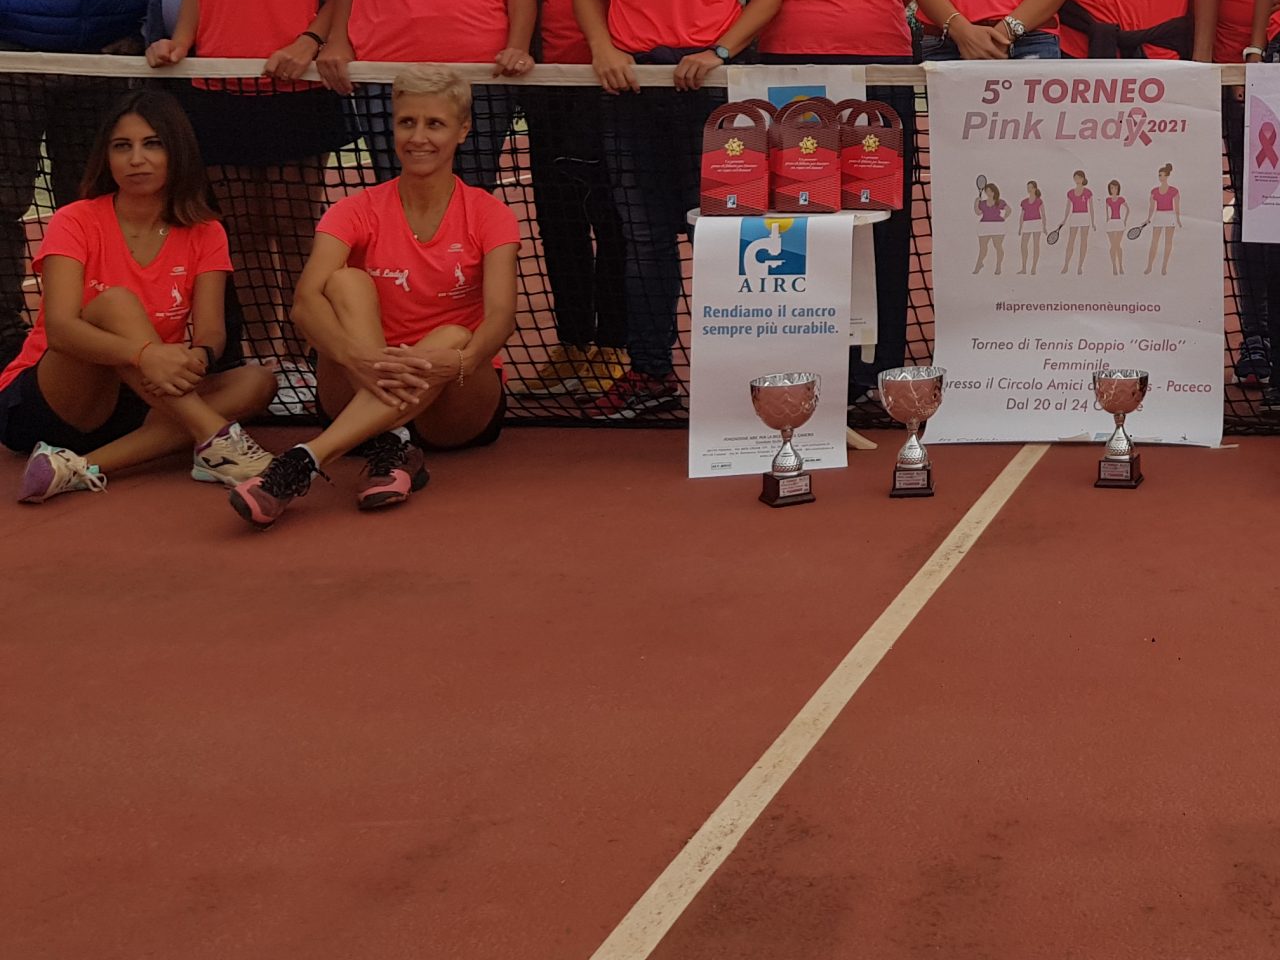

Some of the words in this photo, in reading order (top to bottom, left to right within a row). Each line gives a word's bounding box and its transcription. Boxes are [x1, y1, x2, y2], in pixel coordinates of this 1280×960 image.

[1023, 77, 1165, 104] TORNEO
[962, 111, 1045, 140] Pink
[1055, 110, 1147, 147] Lady
[1147, 119, 1187, 133] 2021
[738, 276, 806, 292] AIRC
[703, 305, 773, 318] Rendiamo
[778, 305, 786, 318] il
[791, 306, 836, 318] cancro
[995, 301, 1161, 314] #laprevenzionenonèungioco
[702, 324, 752, 337] sempre
[757, 322, 778, 337] più
[782, 322, 839, 335] curabile.
[971, 338, 1014, 351] Torneo
[1017, 338, 1030, 351] di
[1035, 338, 1074, 351] Tennis
[1078, 340, 1125, 354] Doppio
[1043, 358, 1110, 371] Femminile
[985, 378, 994, 390] il
[997, 378, 1043, 391] Circolo
[1047, 378, 1083, 391] Amici
[1166, 380, 1212, 393] Paceco
[1006, 398, 1029, 411] Dal
[1033, 398, 1051, 411] 20
[1055, 398, 1068, 411] al
[1072, 400, 1088, 413] 24
